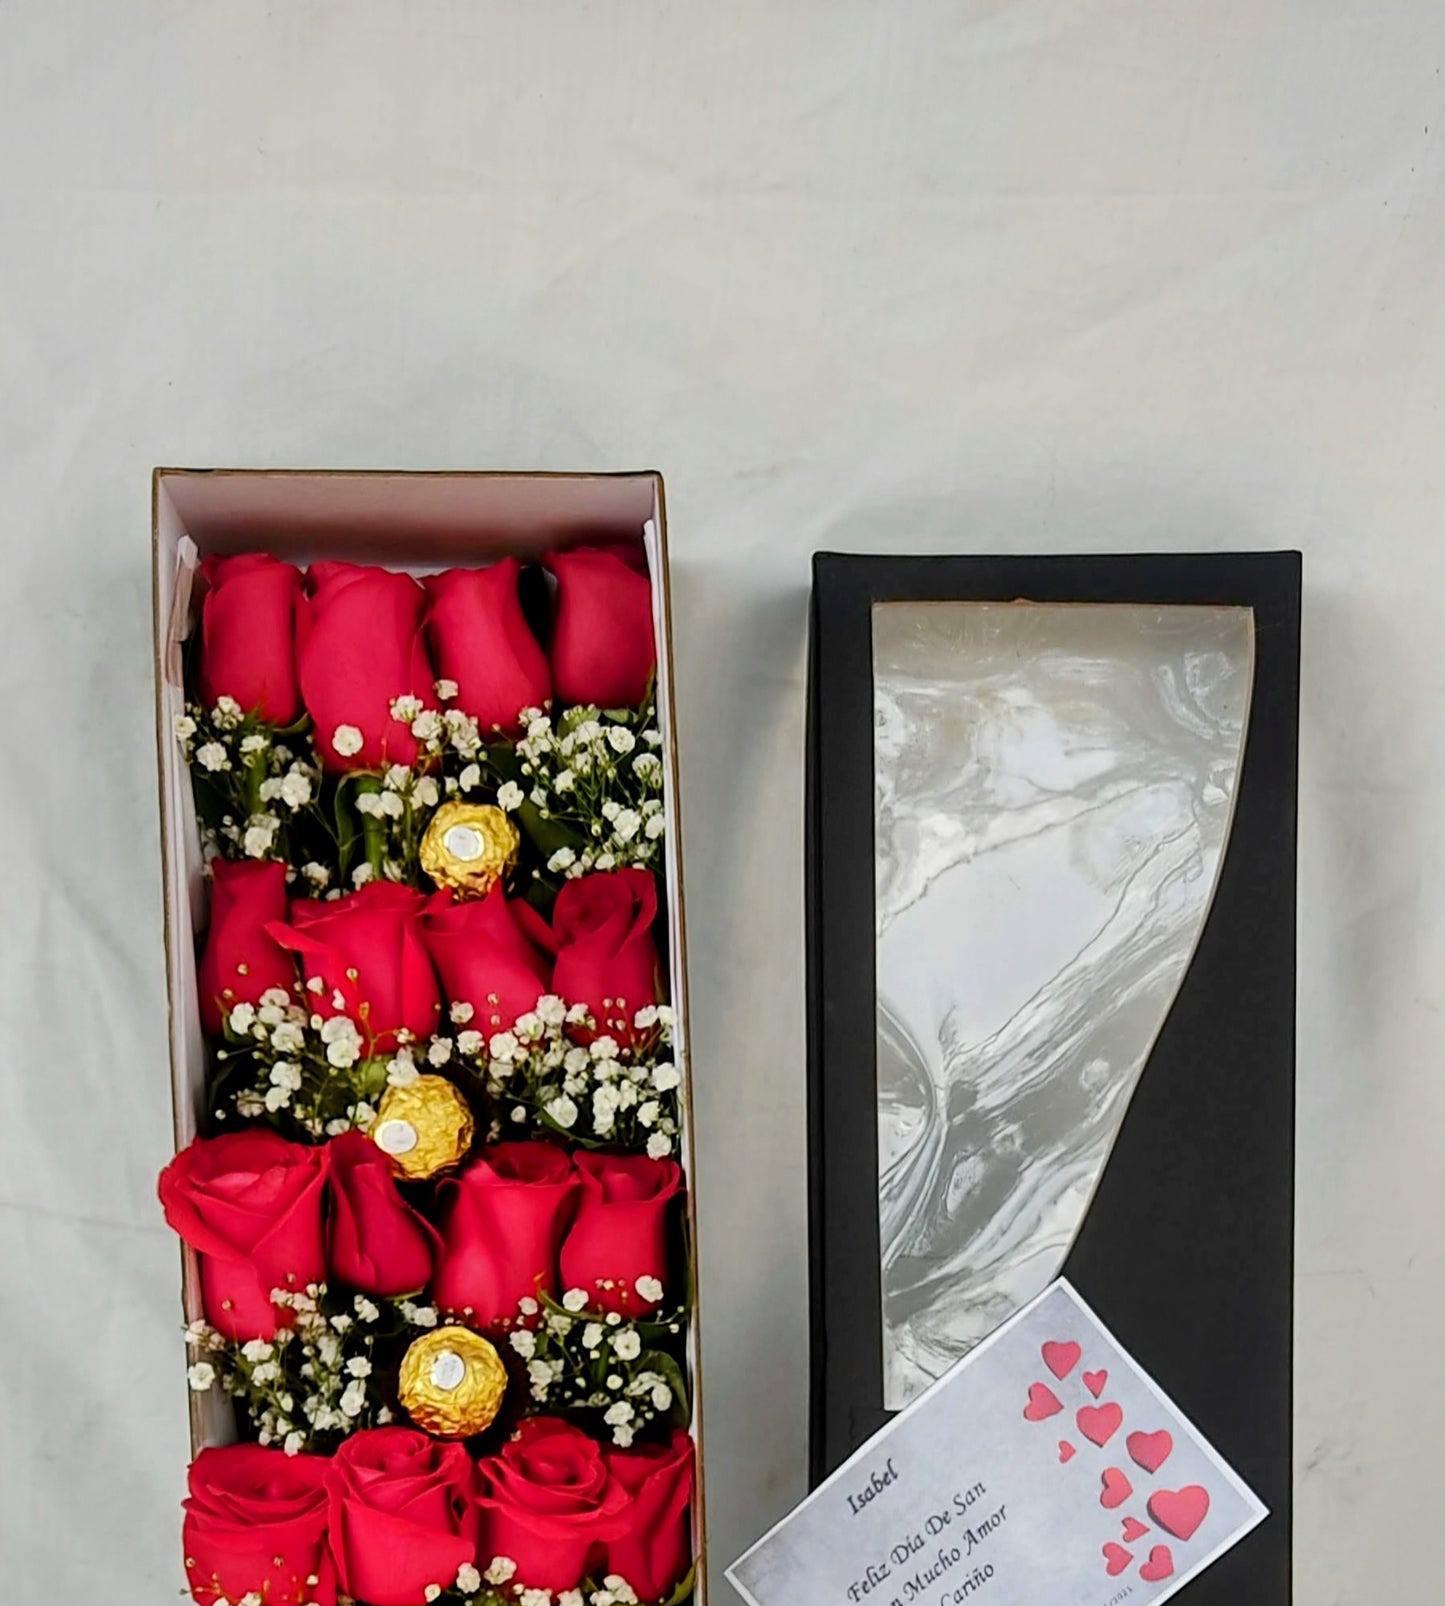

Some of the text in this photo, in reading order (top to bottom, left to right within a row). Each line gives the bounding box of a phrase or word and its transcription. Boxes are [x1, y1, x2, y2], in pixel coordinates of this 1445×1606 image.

[846, 1458, 898, 1515] Isabel
[847, 1563, 891, 1603] Feliz
[925, 1510, 952, 1536] De
[952, 1482, 987, 1516] San
[902, 1549, 961, 1601] Mucho
[962, 1504, 1008, 1556] Amor
